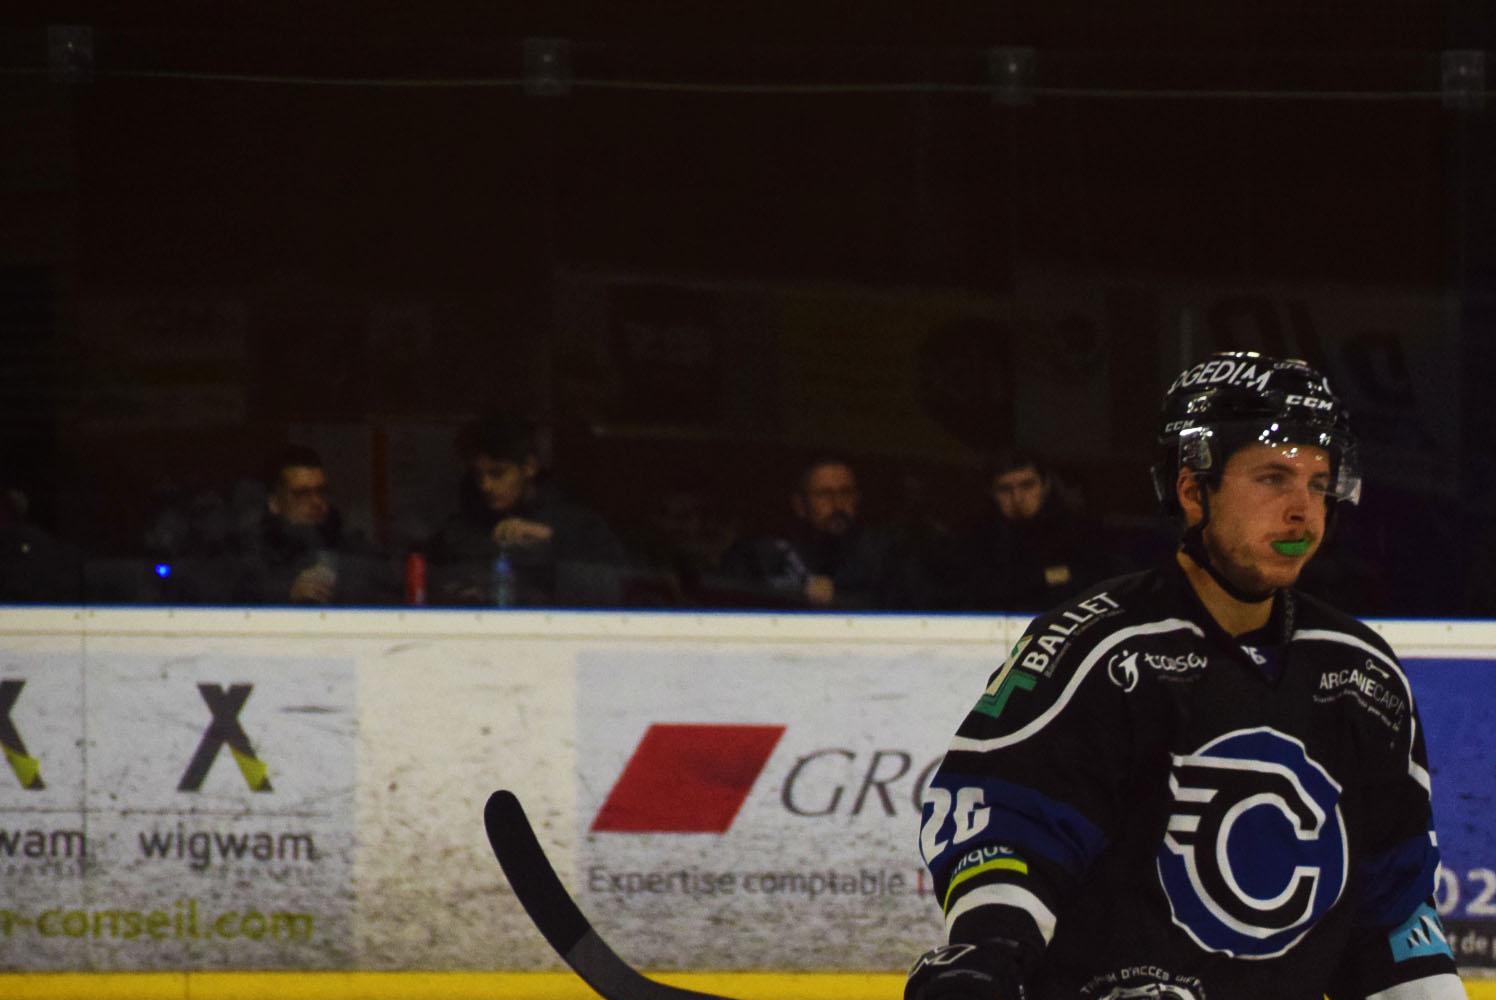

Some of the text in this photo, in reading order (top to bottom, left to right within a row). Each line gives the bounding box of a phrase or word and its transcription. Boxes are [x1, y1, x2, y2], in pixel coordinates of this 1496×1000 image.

[1285, 394, 1334, 411] CCM
[1021, 592, 1120, 673] BALLET
[139, 822, 316, 872] wigwam
[920, 786, 992, 865] 26
[588, 864, 905, 900] Expertise comptable
[1460, 931, 1488, 952] de
